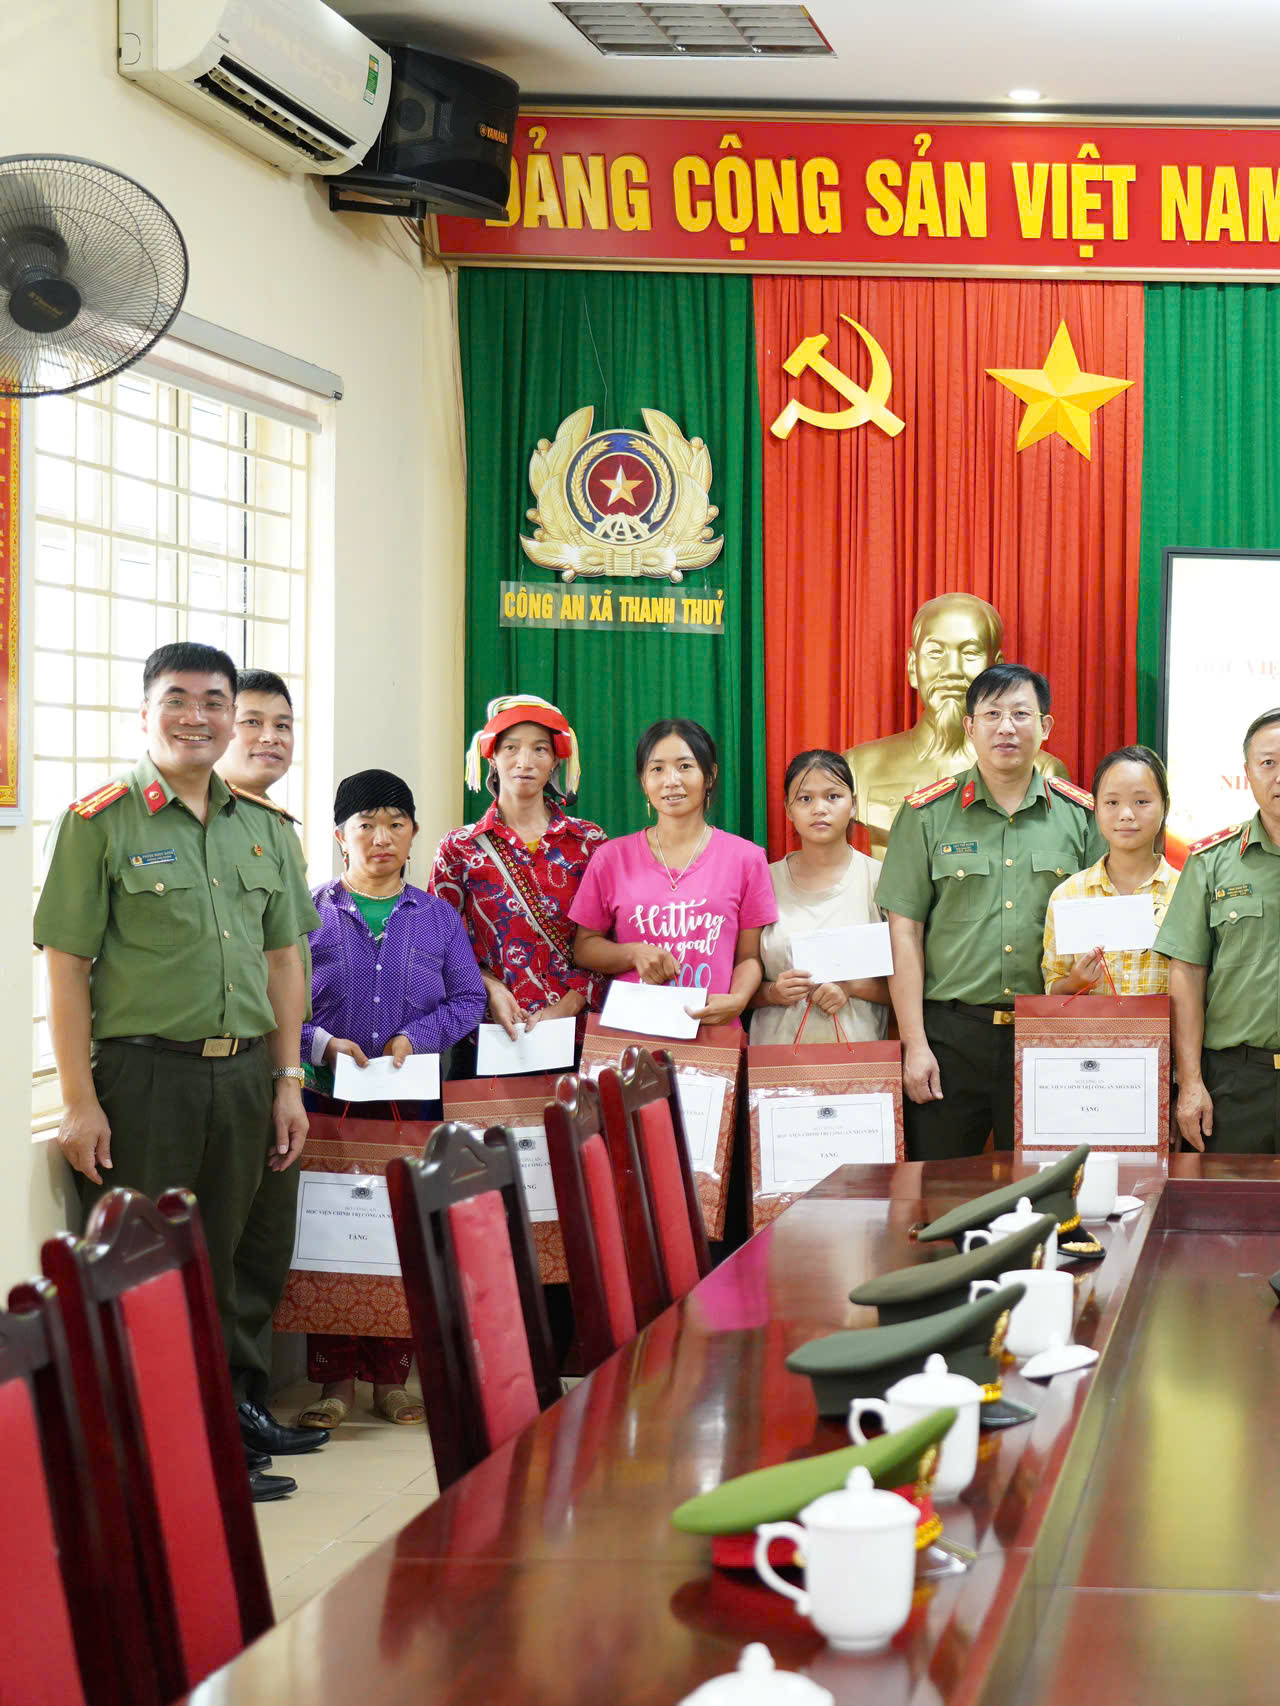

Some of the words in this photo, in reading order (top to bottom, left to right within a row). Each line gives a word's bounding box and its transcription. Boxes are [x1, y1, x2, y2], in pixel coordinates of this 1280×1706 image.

[674, 133, 842, 251] CỘNG
[866, 134, 987, 238] SẢN
[1012, 143, 1137, 258] VIỆT
[503, 588, 554, 619] CÔNG
[559, 594, 585, 620] AN
[589, 589, 614, 621] XÃ
[619, 596, 675, 624] THANH
[682, 590, 724, 625] THUỶ
[628, 898, 727, 941] Hitting
[677, 927, 718, 965] goal
